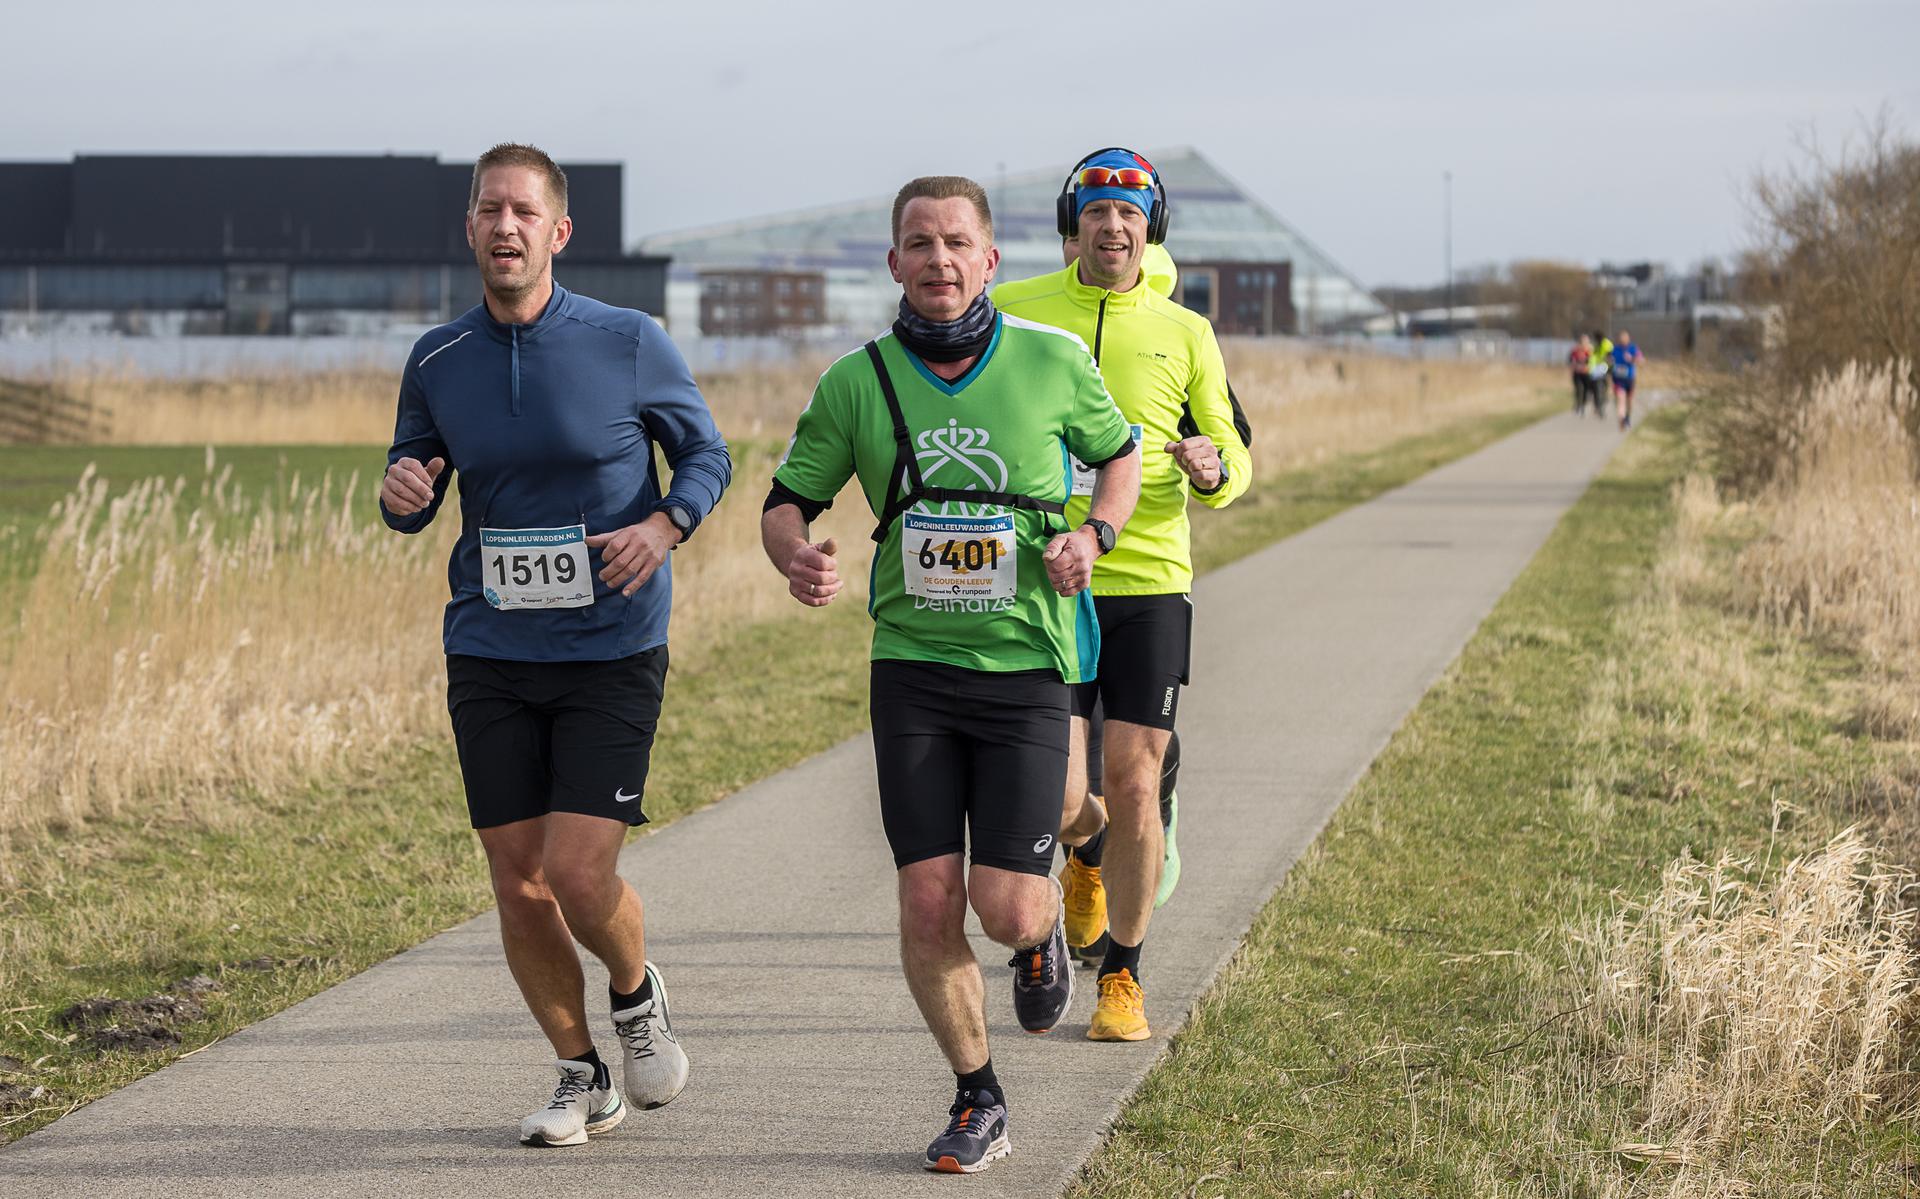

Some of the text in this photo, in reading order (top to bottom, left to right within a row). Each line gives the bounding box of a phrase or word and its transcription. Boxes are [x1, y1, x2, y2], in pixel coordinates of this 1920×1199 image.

[910, 520, 1008, 532] LOPENINLEEUWARDEN.NL
[486, 532, 577, 543] LOPENINLEEUWARDEN.NL
[919, 538, 998, 571] 6401
[492, 552, 577, 586] 1519
[923, 576, 994, 586] DE GOUDEN LEEUW
[962, 588, 993, 597] runpoint
[1162, 686, 1175, 716] FUSION
